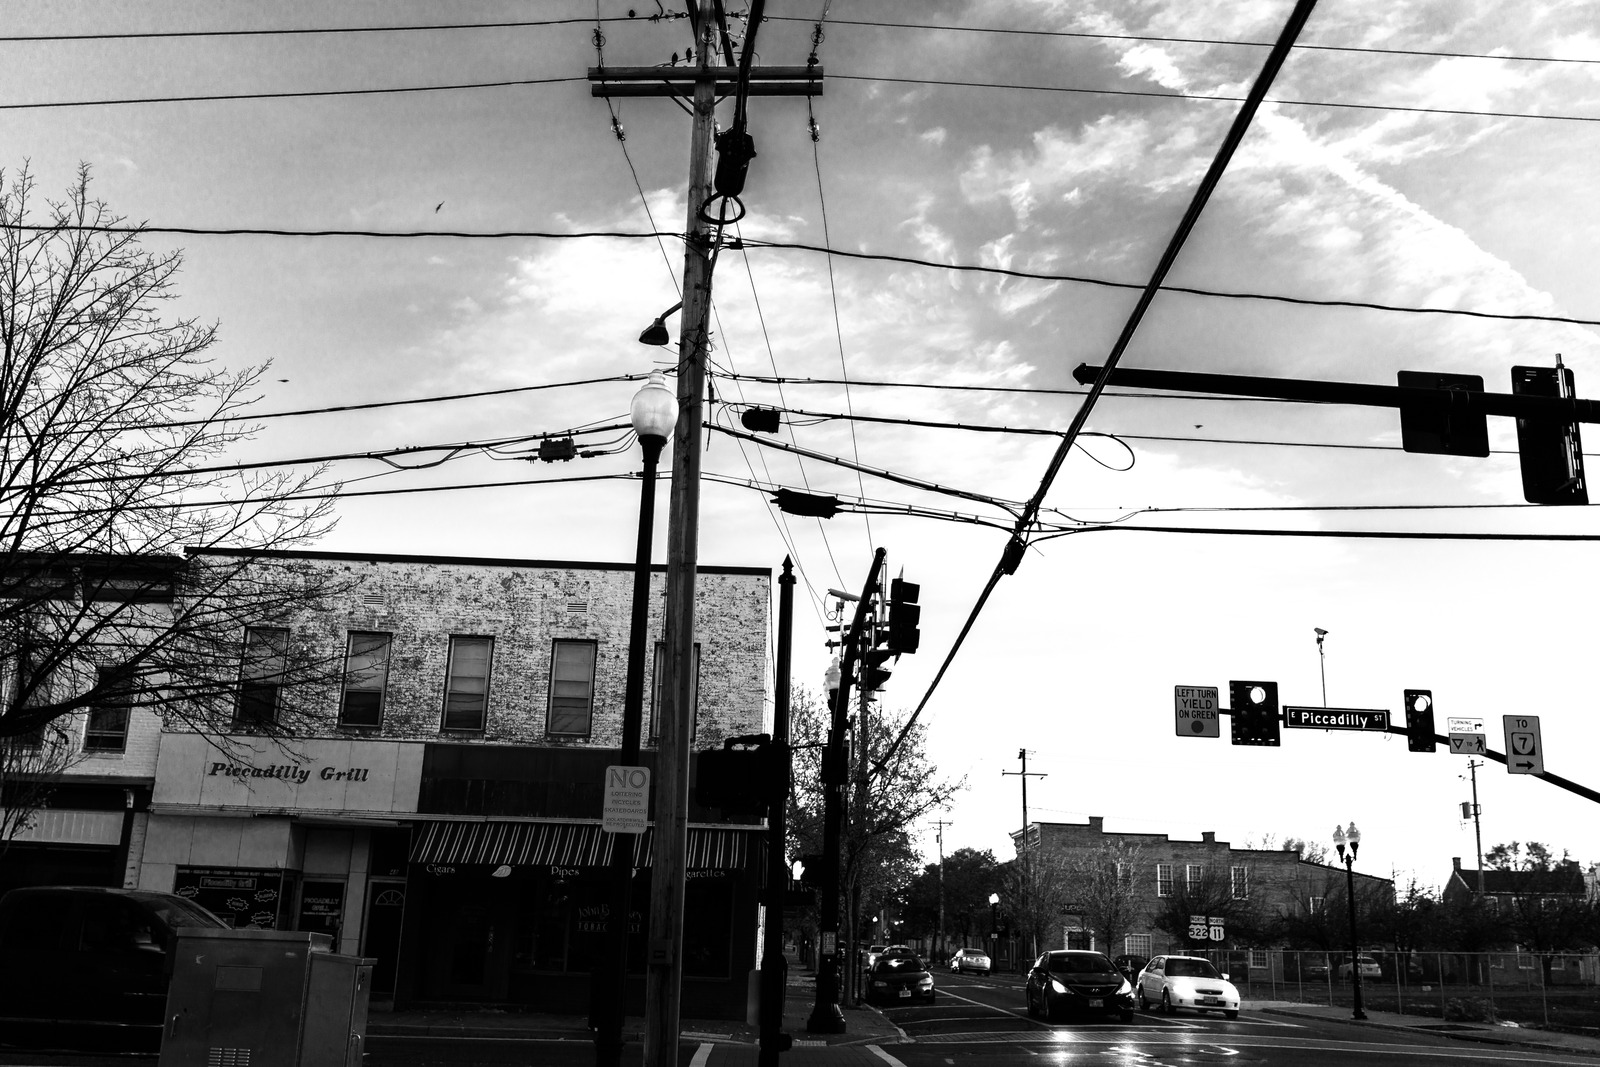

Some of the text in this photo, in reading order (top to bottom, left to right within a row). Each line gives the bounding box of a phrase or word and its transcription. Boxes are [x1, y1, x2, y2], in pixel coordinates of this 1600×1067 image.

[1177, 689, 1216, 698] LEFT TURN
[1181, 699, 1212, 709] YIELD
[1179, 709, 1216, 719] ON GREEN
[1301, 712, 1368, 728] Piccadilly
[1516, 719, 1528, 728] TO
[1518, 737, 1528, 750] 7
[208, 762, 369, 784] Piccadilly Grill
[609, 768, 647, 789] NO
[426, 864, 456, 876] Cigars
[551, 866, 579, 878] Pipes
[1189, 927, 1207, 937] 522
[1213, 929, 1221, 939] 11
